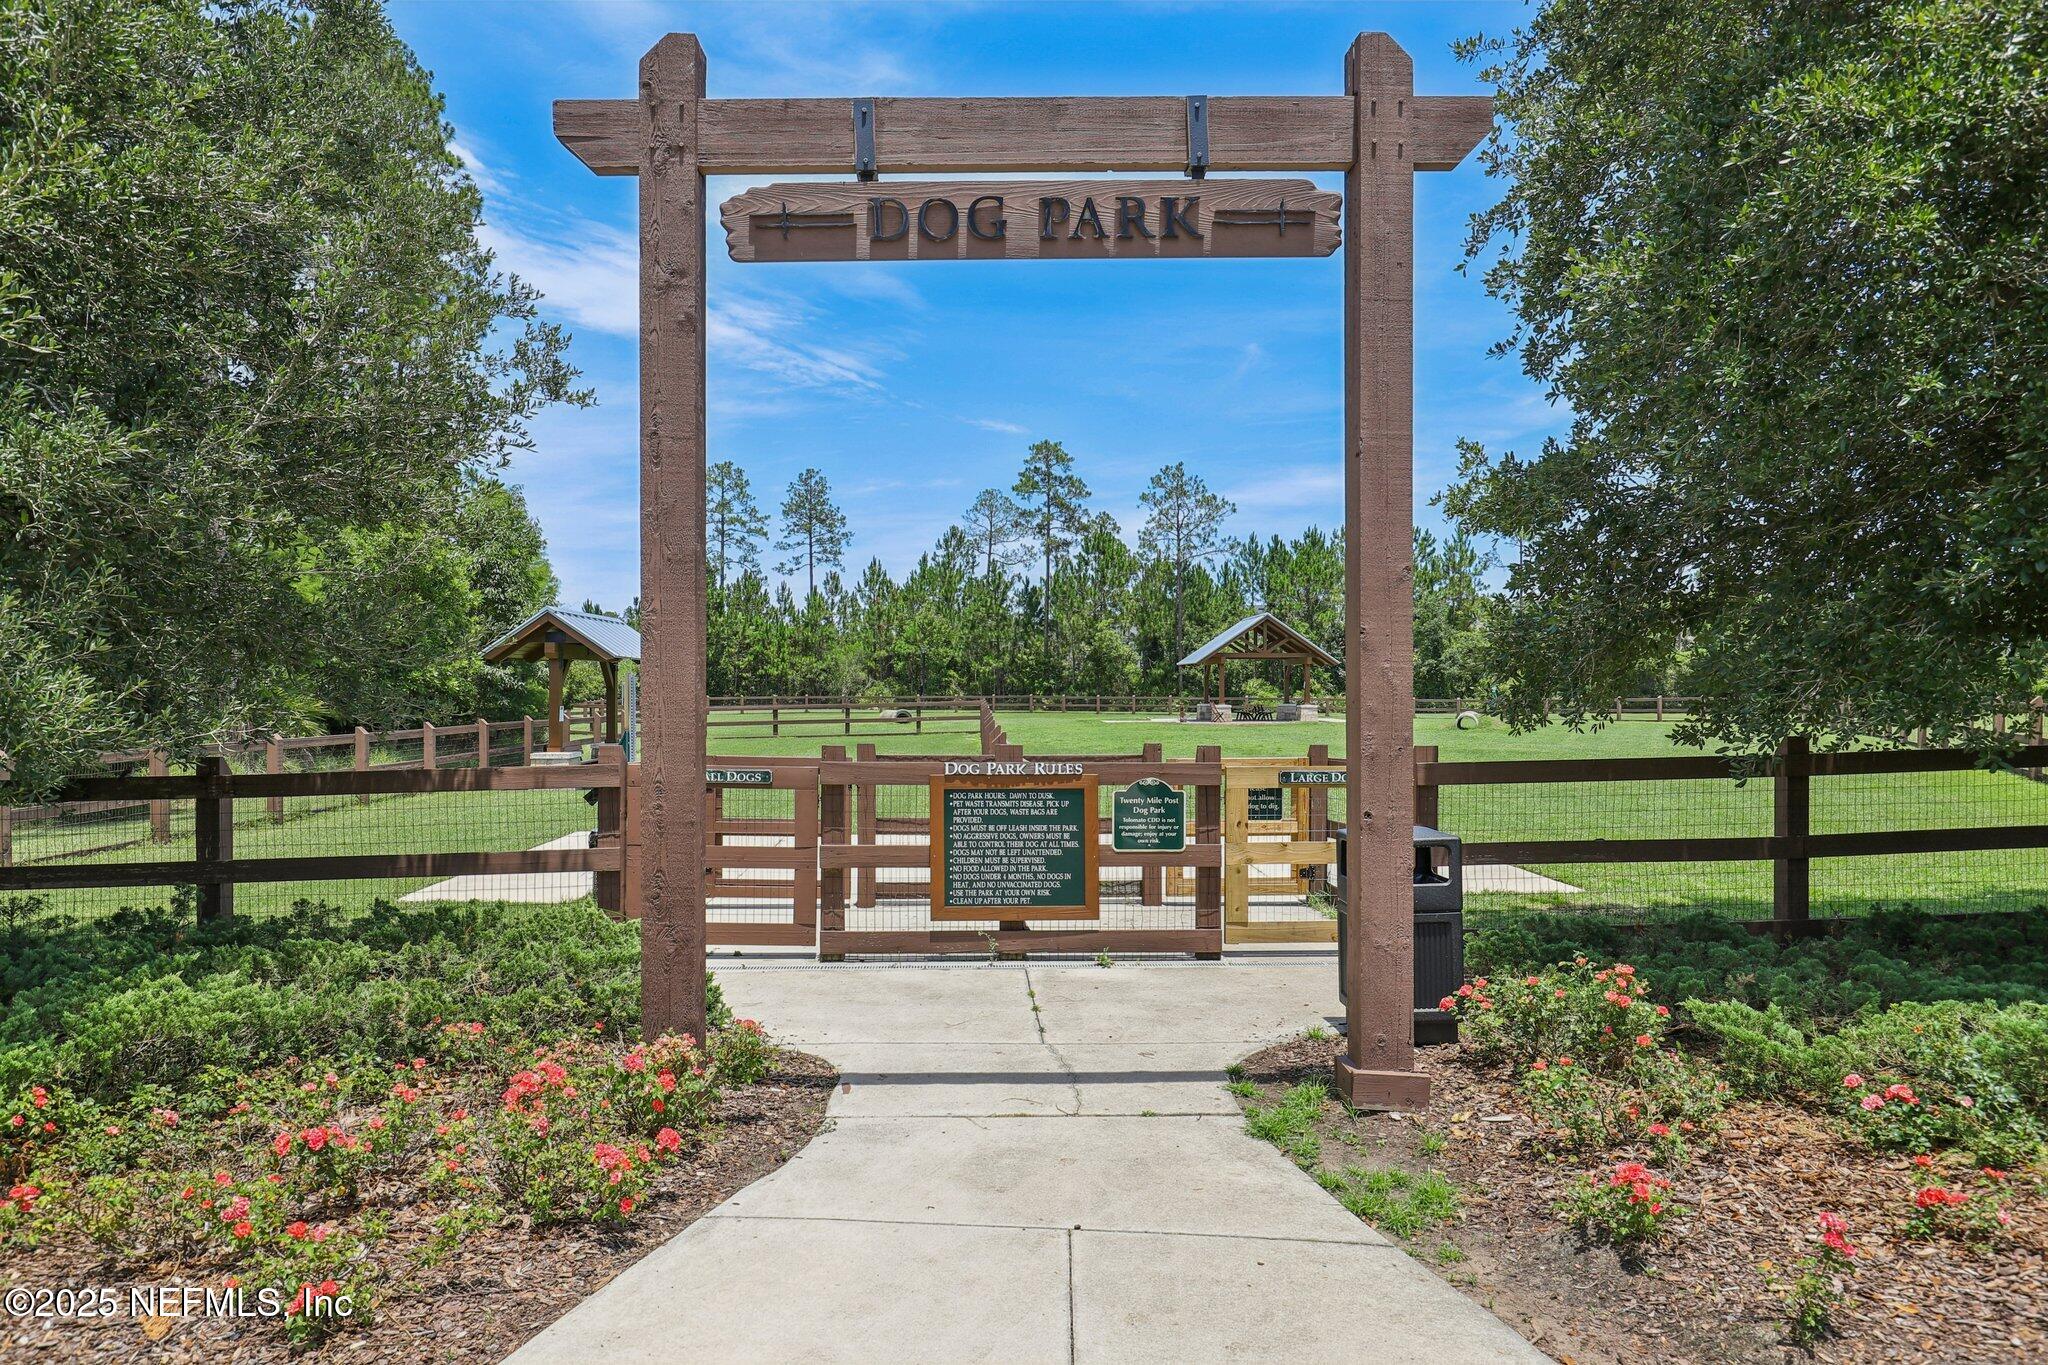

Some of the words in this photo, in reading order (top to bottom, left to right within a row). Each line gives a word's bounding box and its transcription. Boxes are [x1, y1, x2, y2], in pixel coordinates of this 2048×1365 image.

[867, 197, 1007, 241] DOG
[1039, 197, 1204, 241] PARK
[944, 762, 980, 775] DOG
[987, 762, 1026, 775] PARK
[1034, 762, 1083, 775] RULES
[727, 772, 761, 781] DOGS
[1290, 772, 1328, 782] LARGE
[1120, 797, 1144, 805] Twenty
[1133, 807, 1148, 815] Dog
